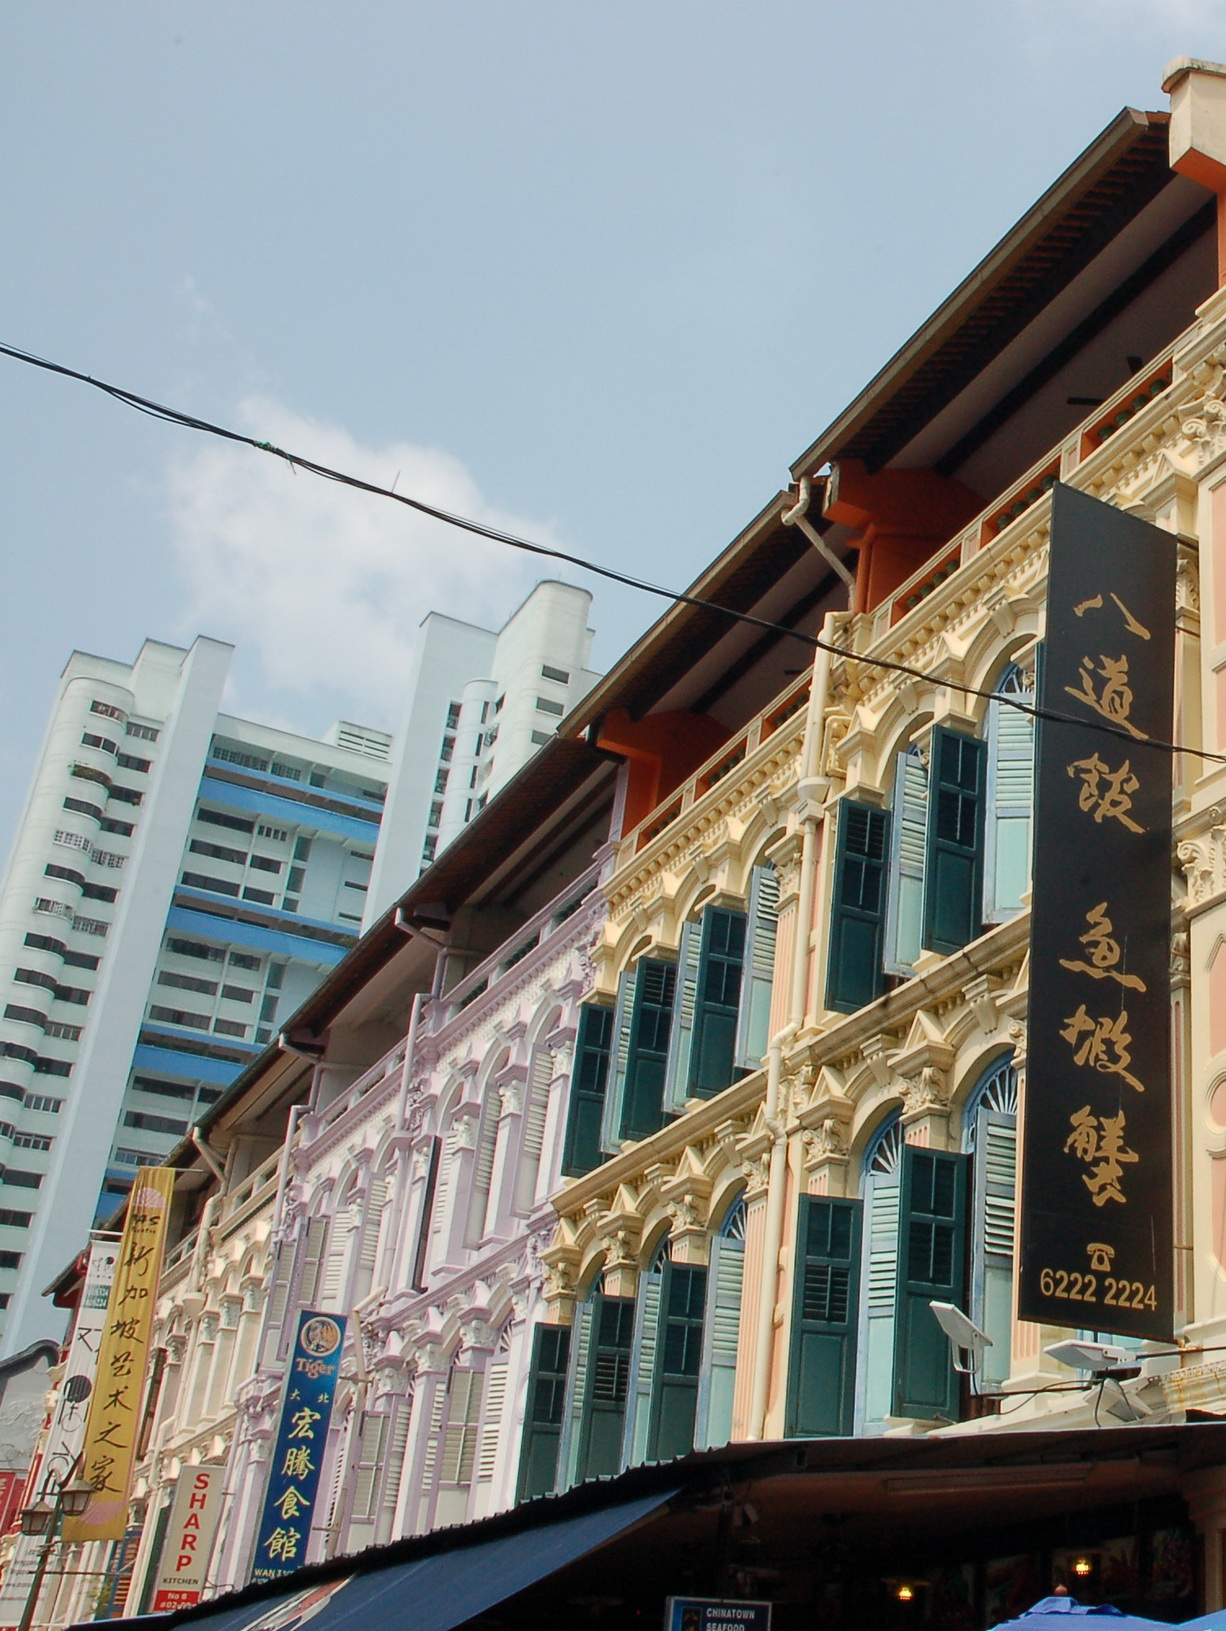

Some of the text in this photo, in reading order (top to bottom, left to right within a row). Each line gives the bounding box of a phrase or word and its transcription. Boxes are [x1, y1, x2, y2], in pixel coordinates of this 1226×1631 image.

[1040, 1268, 1157, 1311] 6222 2224
[296, 1358, 335, 1379] Tiger
[176, 1472, 210, 1572] SHARP
[163, 1576, 199, 1585] KITCHEN
[706, 1607, 755, 1619] CHINATOWN
[706, 1622, 745, 1631] SEAFOOD
